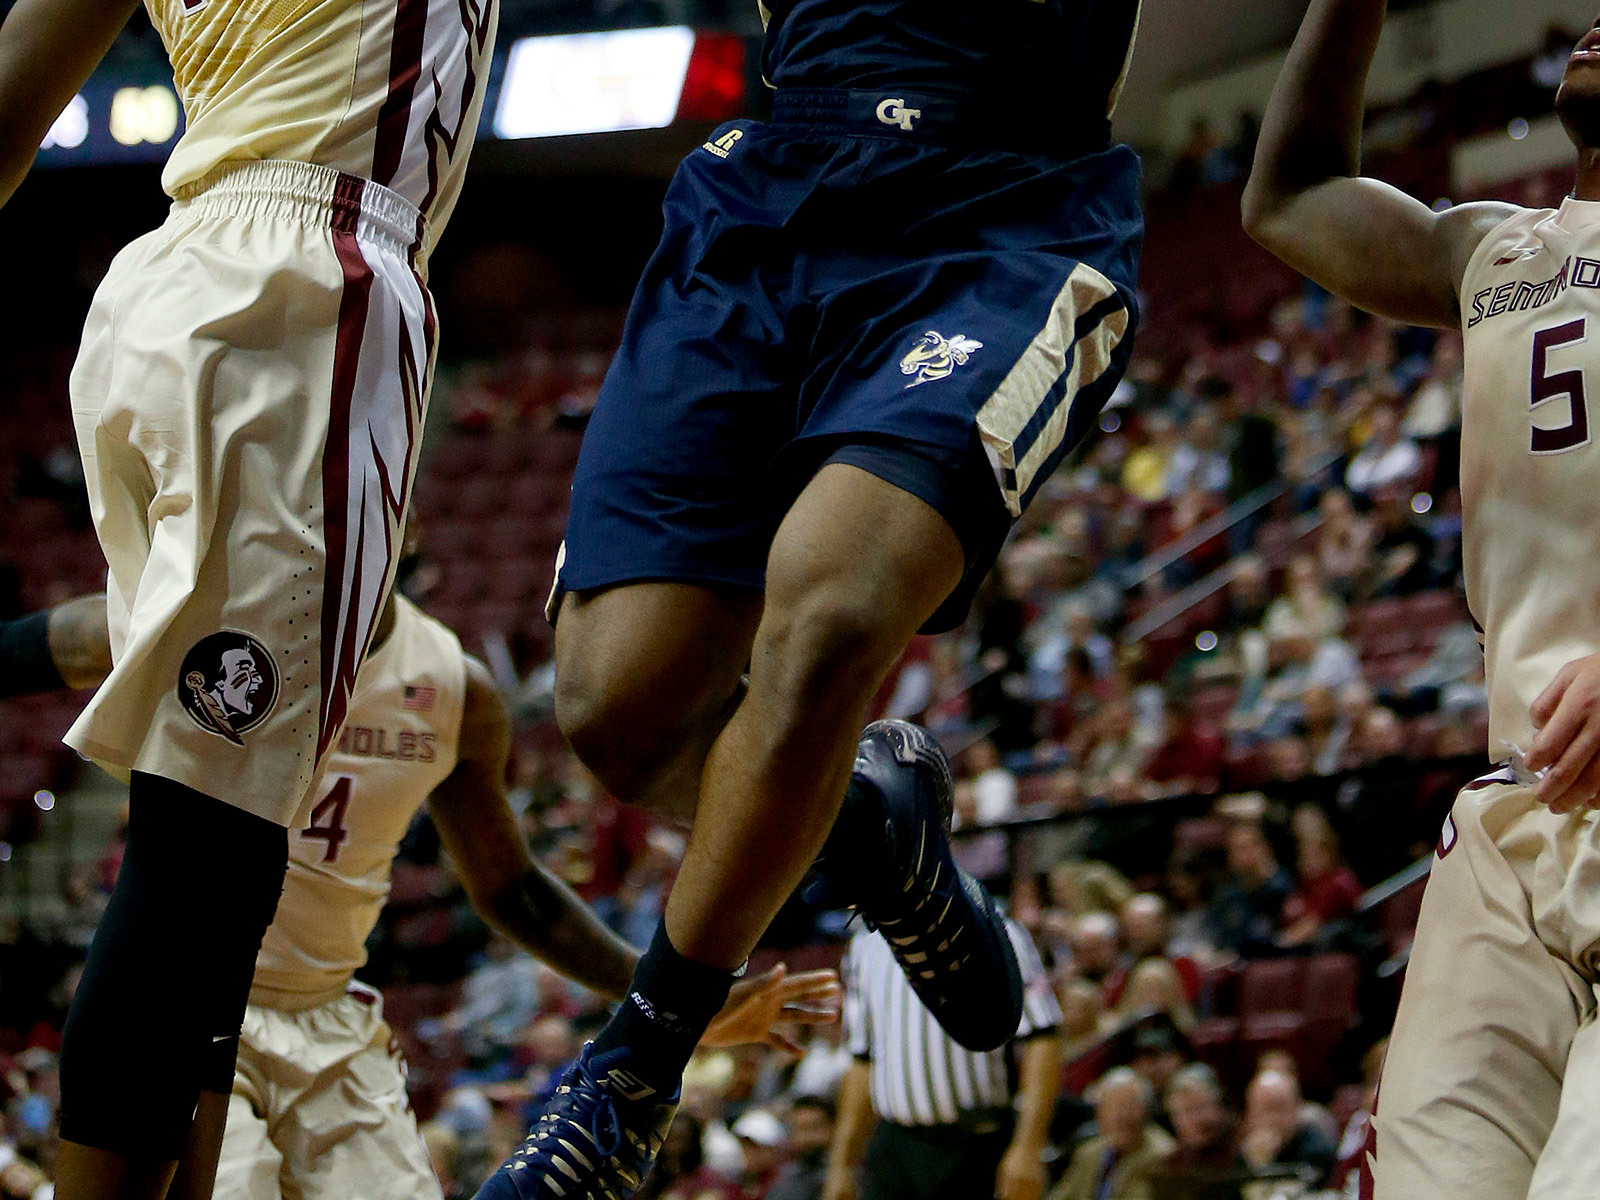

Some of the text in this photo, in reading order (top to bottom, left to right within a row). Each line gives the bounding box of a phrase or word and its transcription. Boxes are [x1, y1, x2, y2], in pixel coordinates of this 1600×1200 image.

[876, 98, 921, 131] GT
[1528, 314, 1593, 457] 5
[299, 774, 356, 864] 4
